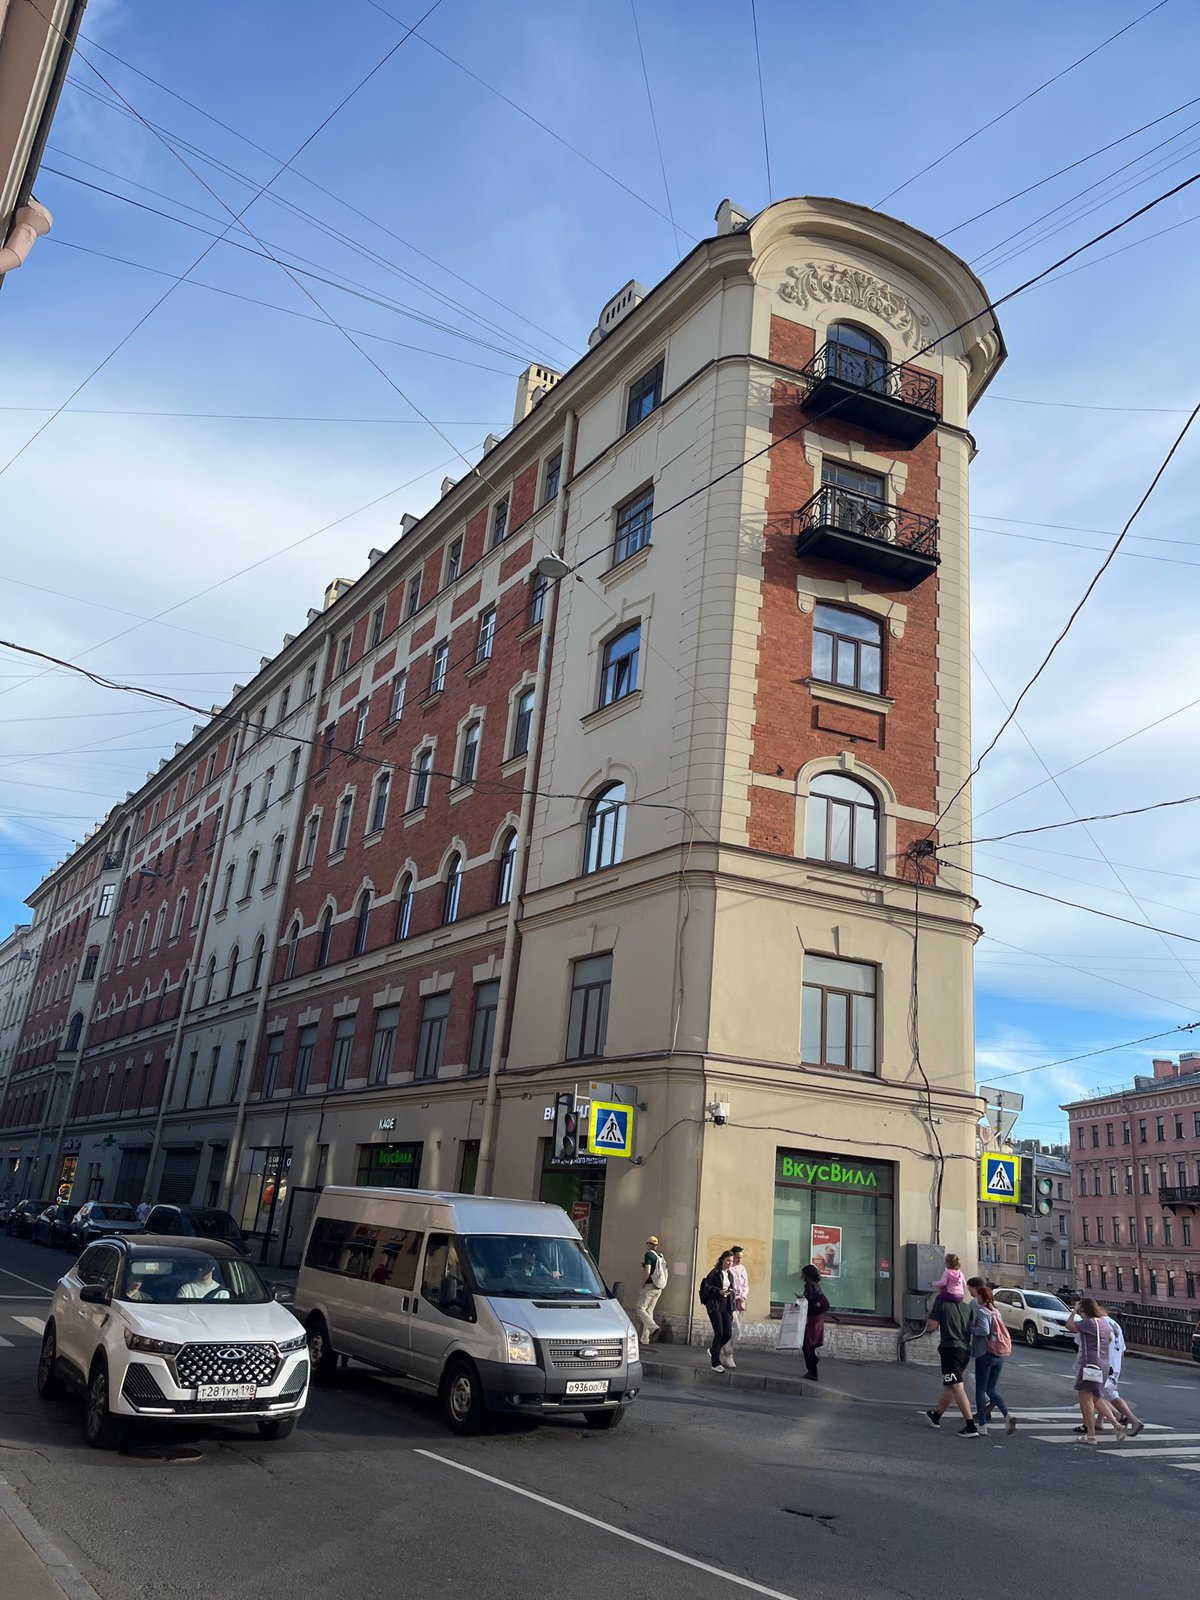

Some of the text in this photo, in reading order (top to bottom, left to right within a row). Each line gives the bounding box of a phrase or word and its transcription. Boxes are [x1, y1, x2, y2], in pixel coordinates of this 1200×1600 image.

[379, 1117, 396, 1130] КАФЕ
[783, 1157, 878, 1186] ВкусВилл
[240, 1384, 255, 1395] 198
